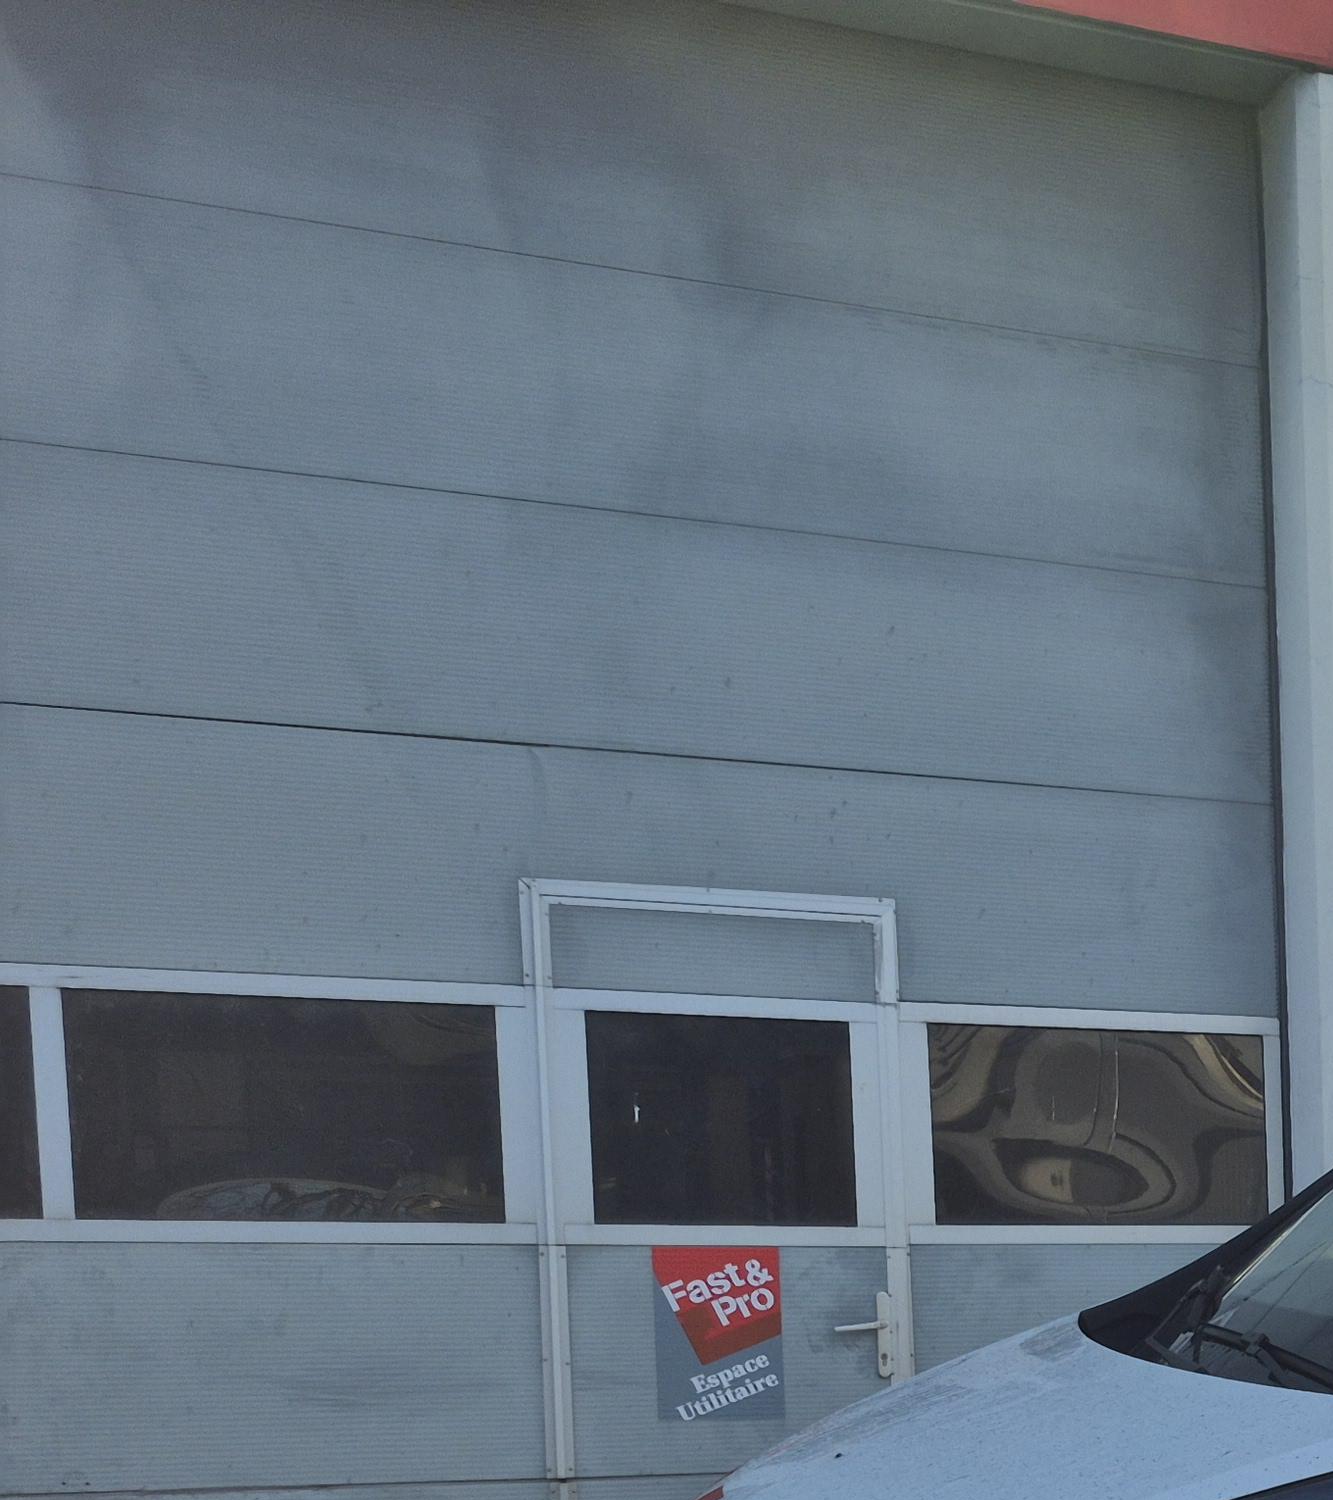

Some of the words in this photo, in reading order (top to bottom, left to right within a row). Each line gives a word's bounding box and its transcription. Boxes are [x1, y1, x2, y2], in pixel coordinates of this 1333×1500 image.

[661, 1259, 774, 1313] Fast&
[710, 1287, 775, 1327] Pro
[690, 1354, 770, 1394] Espace
[676, 1374, 779, 1421] Utilitaire
